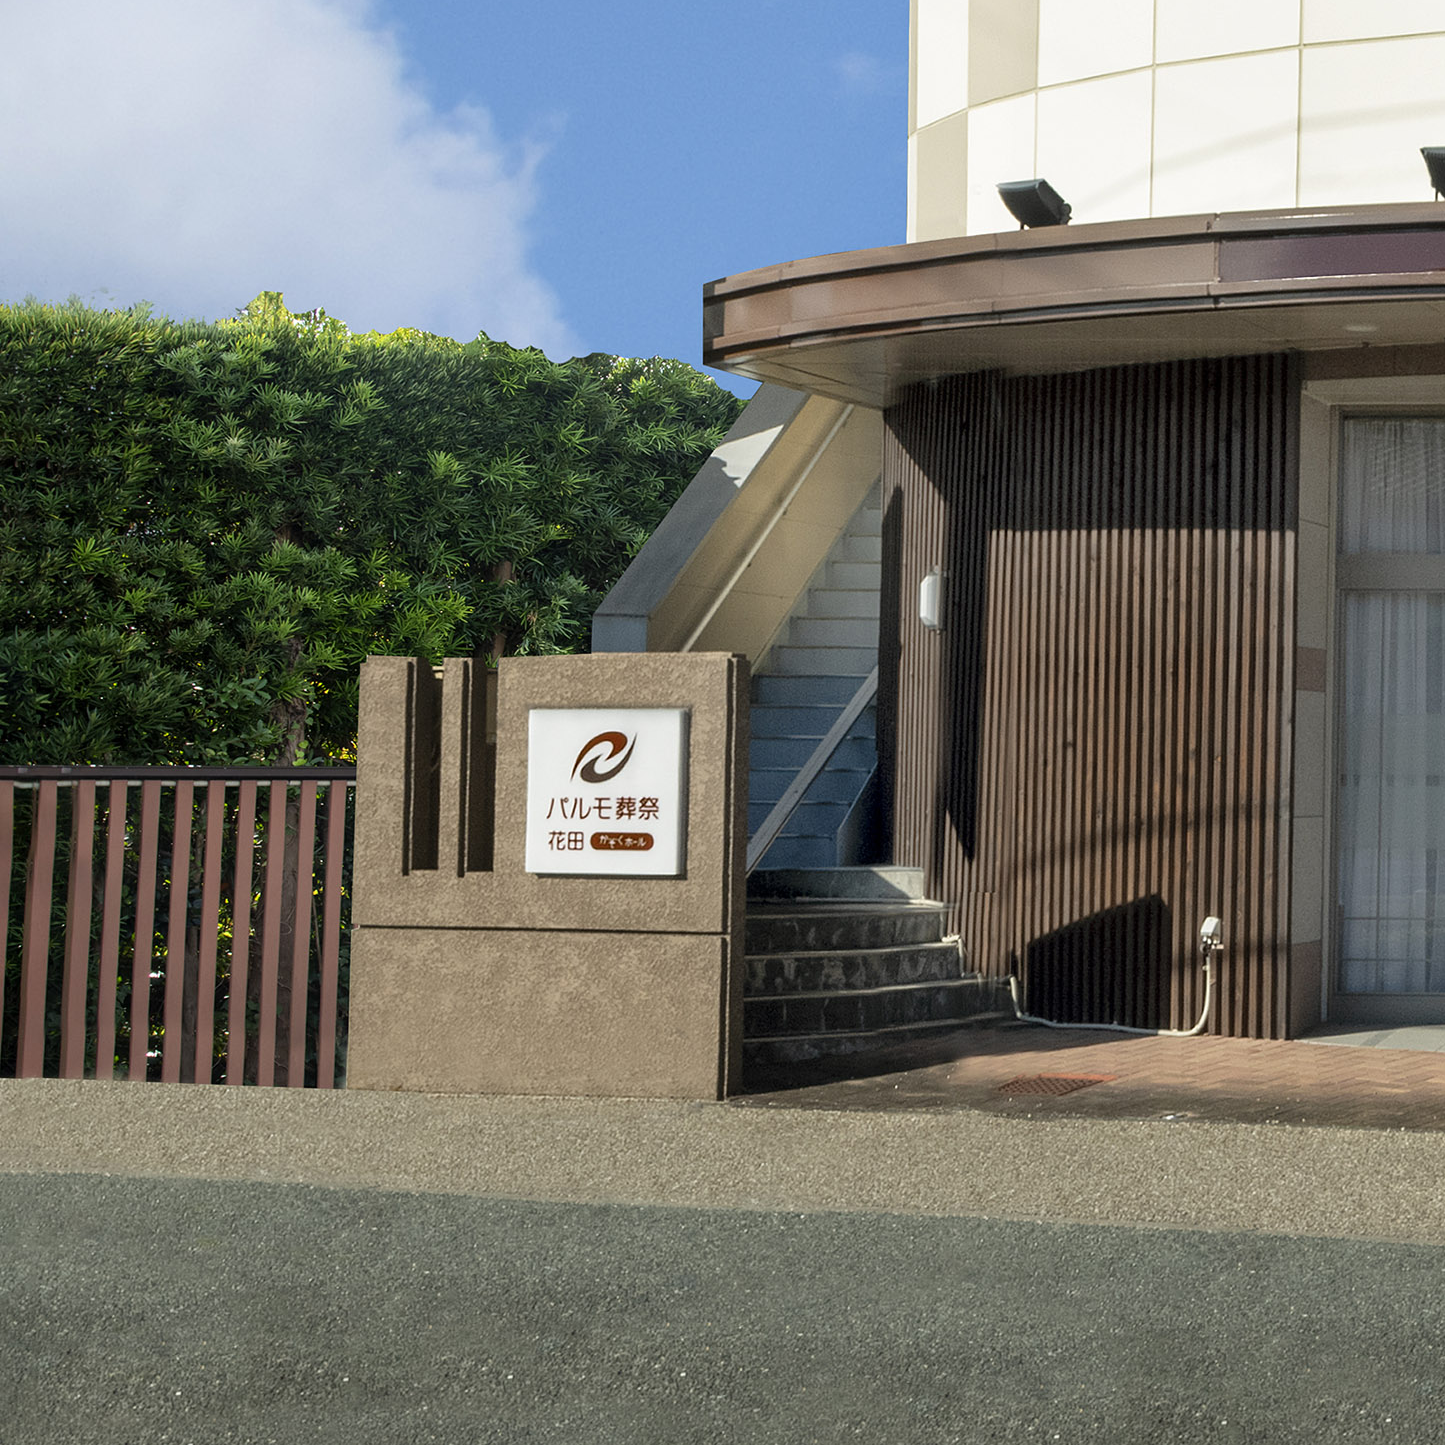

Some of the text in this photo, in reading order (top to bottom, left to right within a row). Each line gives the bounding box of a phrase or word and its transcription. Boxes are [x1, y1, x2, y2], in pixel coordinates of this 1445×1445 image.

[545, 796, 660, 821] パルモ葬祭
[547, 829, 585, 851] 花田
